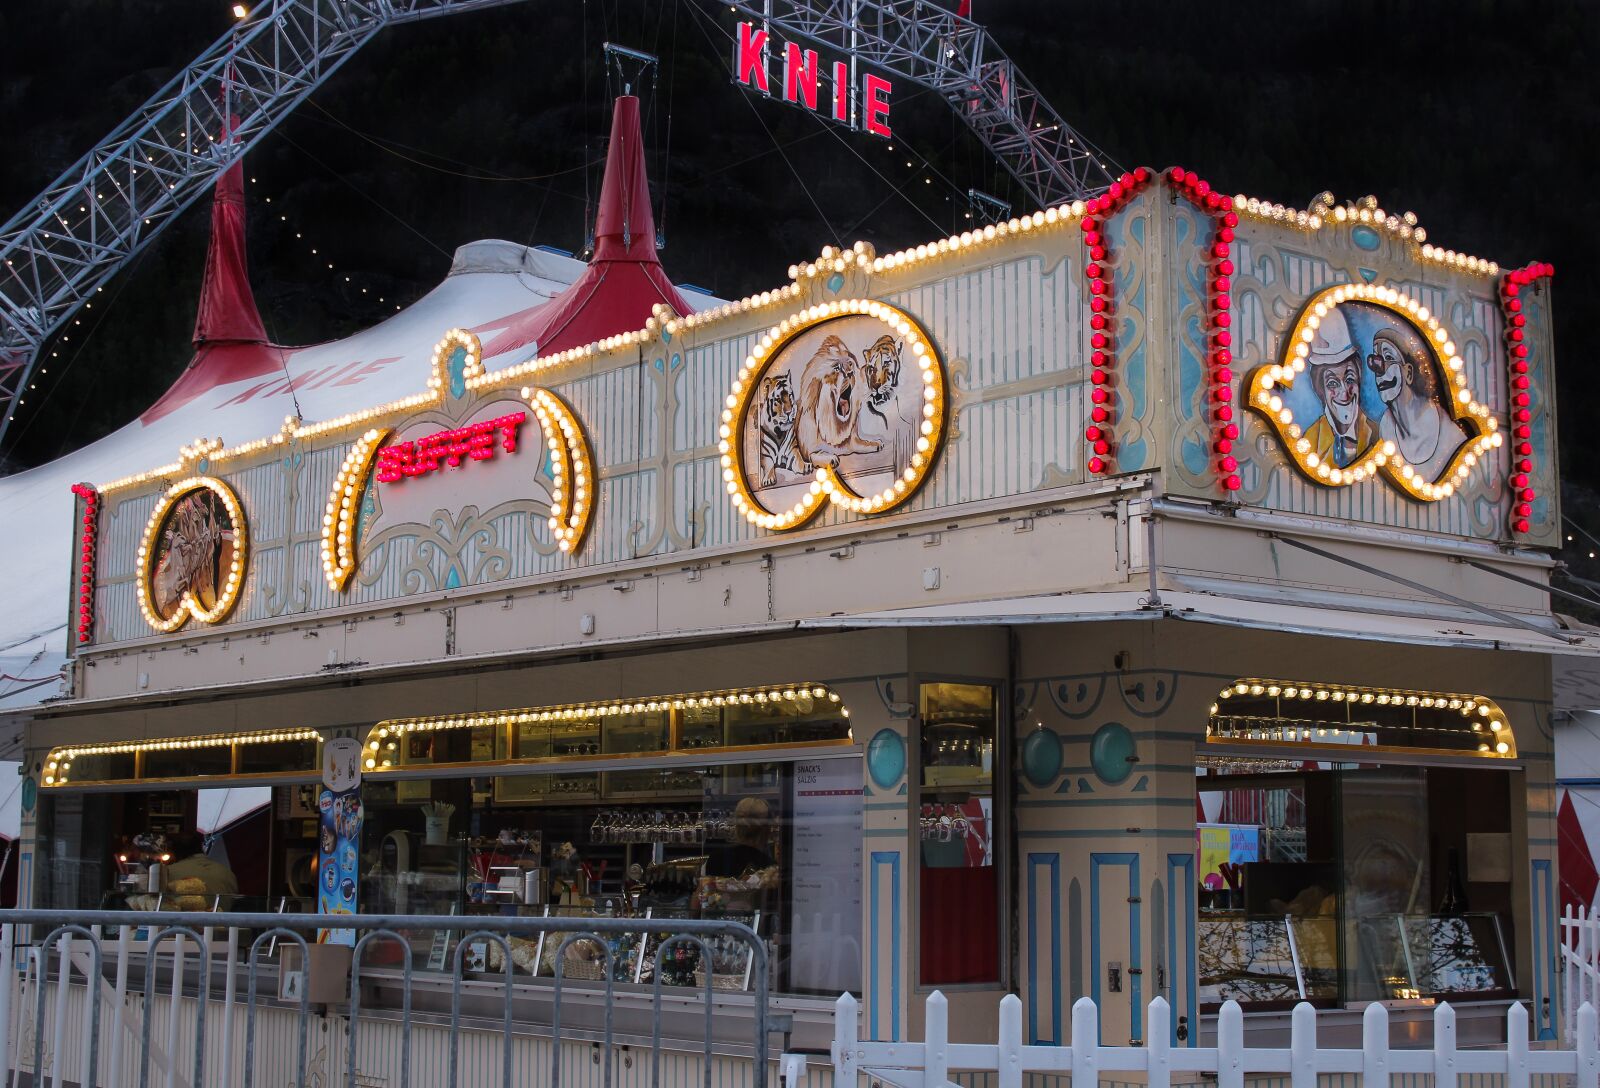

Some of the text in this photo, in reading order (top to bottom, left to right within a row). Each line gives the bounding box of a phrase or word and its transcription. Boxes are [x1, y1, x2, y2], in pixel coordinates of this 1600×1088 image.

[737, 22, 892, 139] KNIE
[377, 411, 526, 483] BUFFET
[797, 765, 821, 774] SNACK'S
